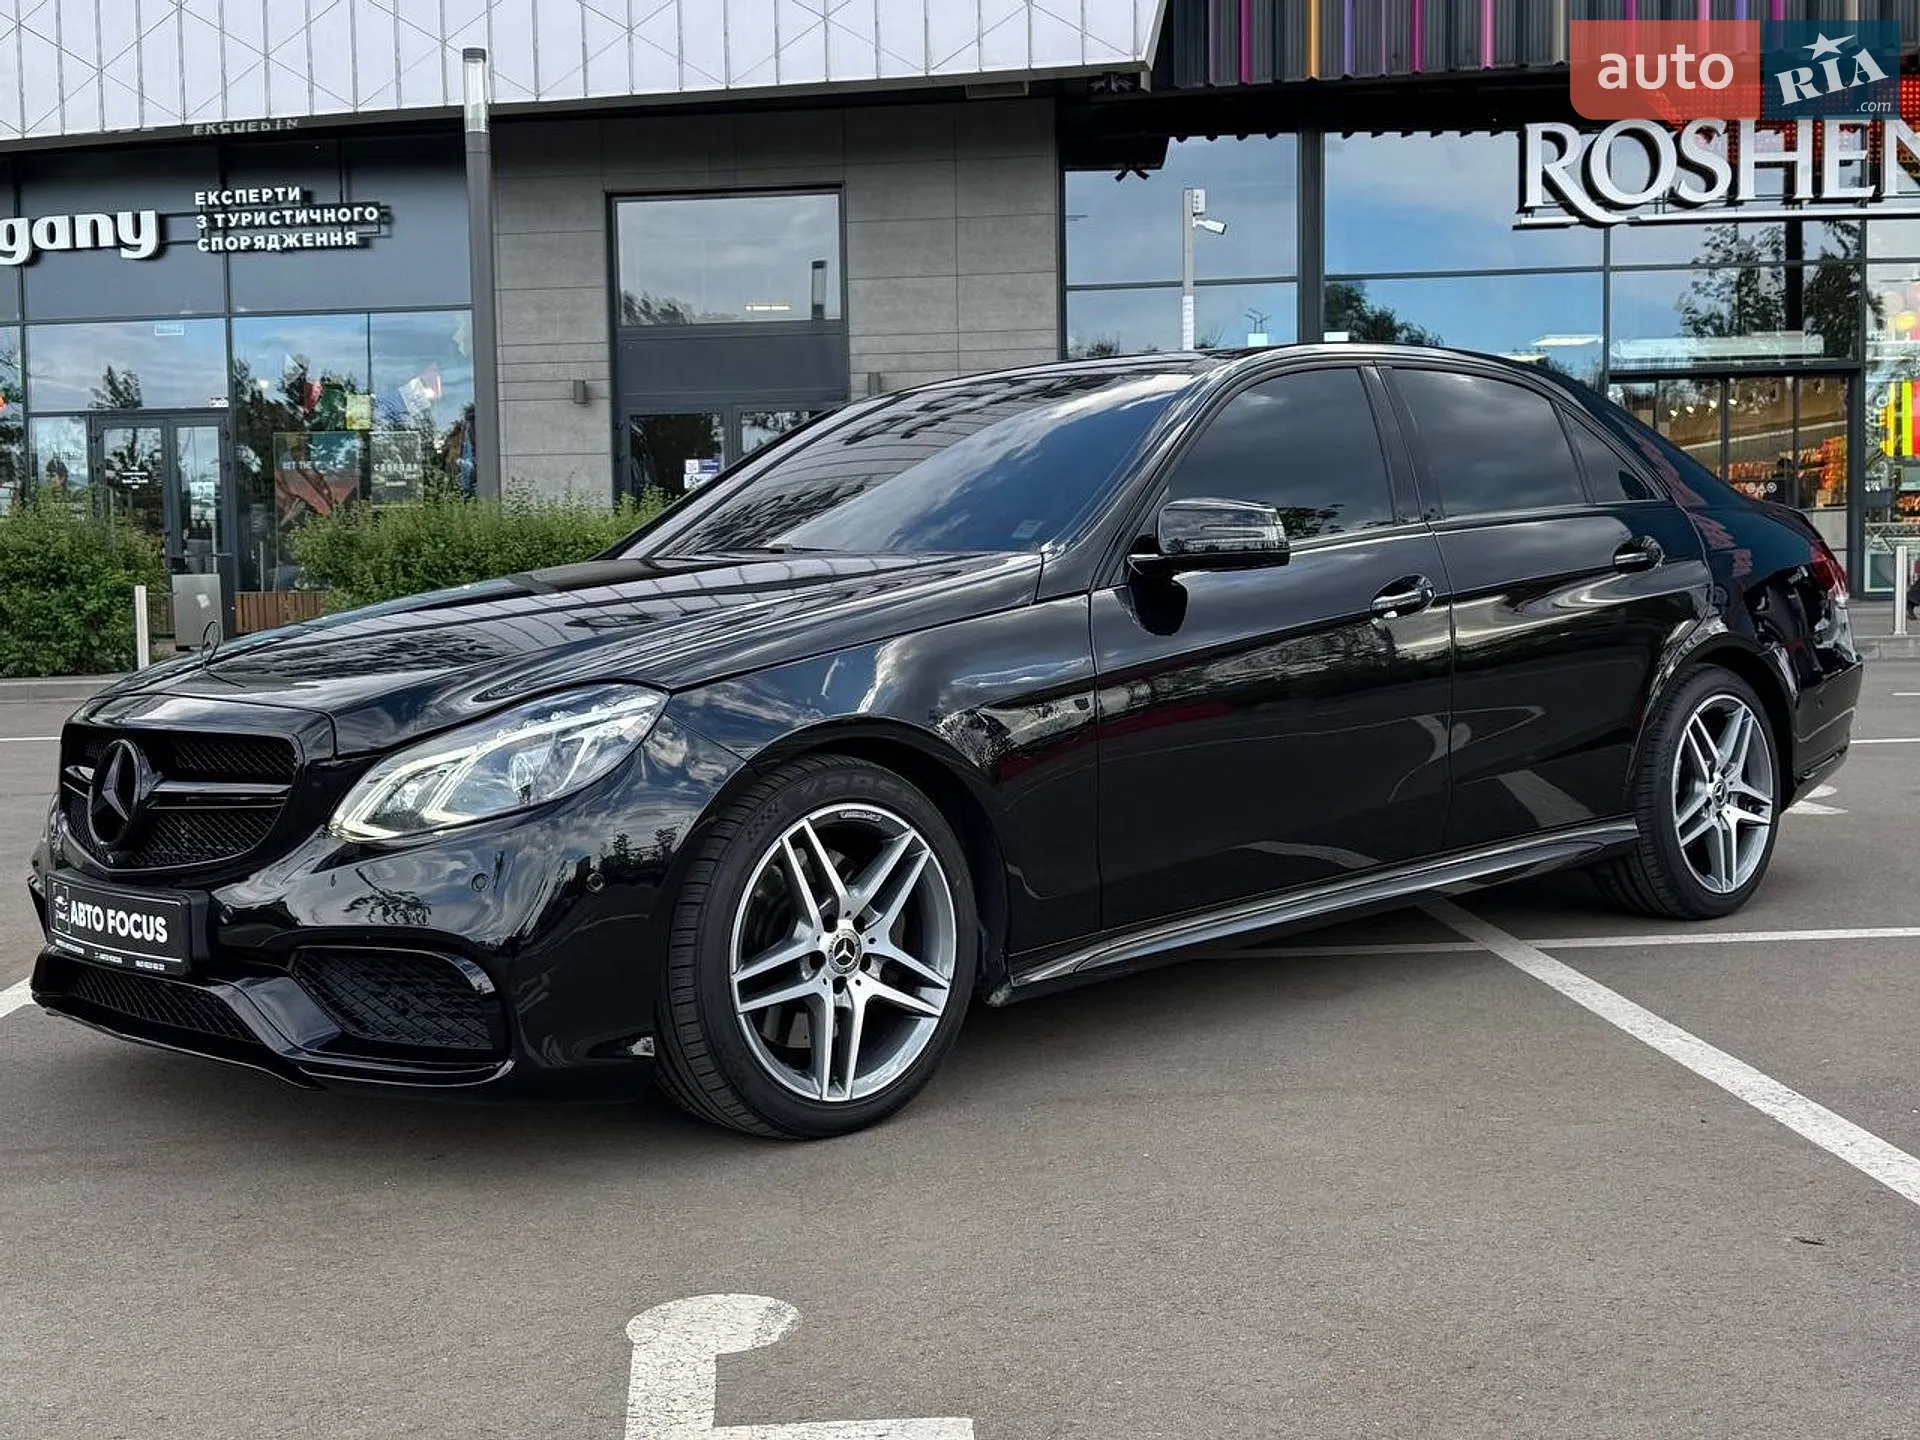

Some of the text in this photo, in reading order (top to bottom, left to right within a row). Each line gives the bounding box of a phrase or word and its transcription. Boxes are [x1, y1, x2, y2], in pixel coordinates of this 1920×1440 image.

[194, 186, 300, 206] ЕКСПЕРТИ
[213, 206, 379, 229] ТУРИСТИЧНОГО
[0, 209, 157, 265] gany
[197, 230, 358, 252] СПОРЯДЖЕННЯ
[106, 908, 168, 943] FOCUS
